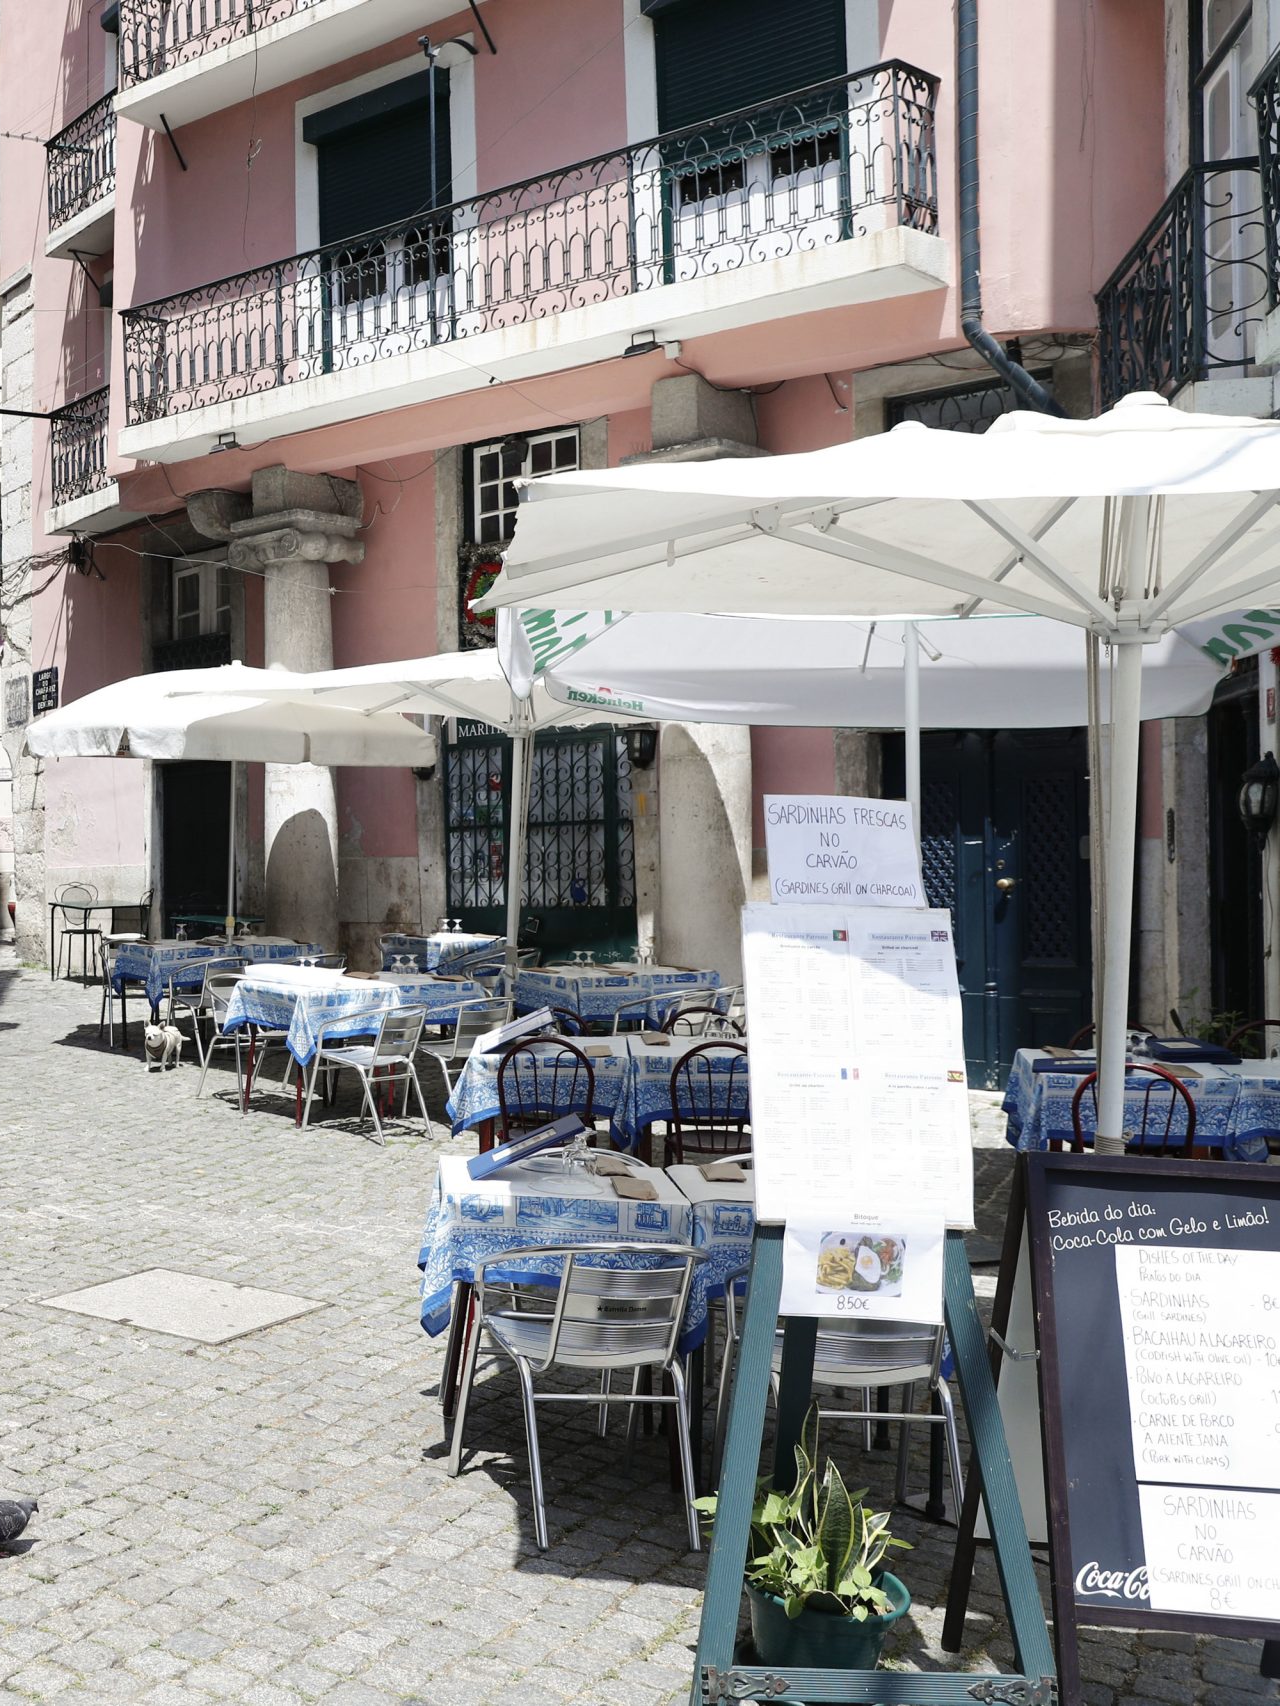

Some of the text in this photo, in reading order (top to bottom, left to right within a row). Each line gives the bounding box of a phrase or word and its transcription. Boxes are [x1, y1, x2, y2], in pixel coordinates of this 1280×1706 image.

[853, 807, 907, 830] FRESCAS
[819, 832, 840, 848] NO
[805, 850, 858, 870] CARVÃO
[775, 877, 828, 897] (SARDINES
[855, 883, 868, 895] ON
[853, 1213, 879, 1221] Bitoque
[1047, 1201, 1157, 1228] Bebida do dia:
[1052, 1206, 1270, 1251] Coca-Cola com Gelo e Limão!
[1197, 1252, 1215, 1264] THE
[1169, 1272, 1181, 1282] DO
[1185, 1272, 1202, 1282] DIA
[1130, 1288, 1210, 1309] SARDINHAS
[1176, 1371, 1243, 1386] LAGAREIRO
[1138, 1411, 1180, 1429] CARNE
[1181, 1413, 1198, 1428] DE
[1162, 1494, 1257, 1521] SARDINHAS
[1194, 1522, 1218, 1541] NO
[1176, 1542, 1234, 1565] CARVÃO
[1074, 1561, 1151, 1601] Coca-Co
[1247, 1576, 1263, 1590] ON
